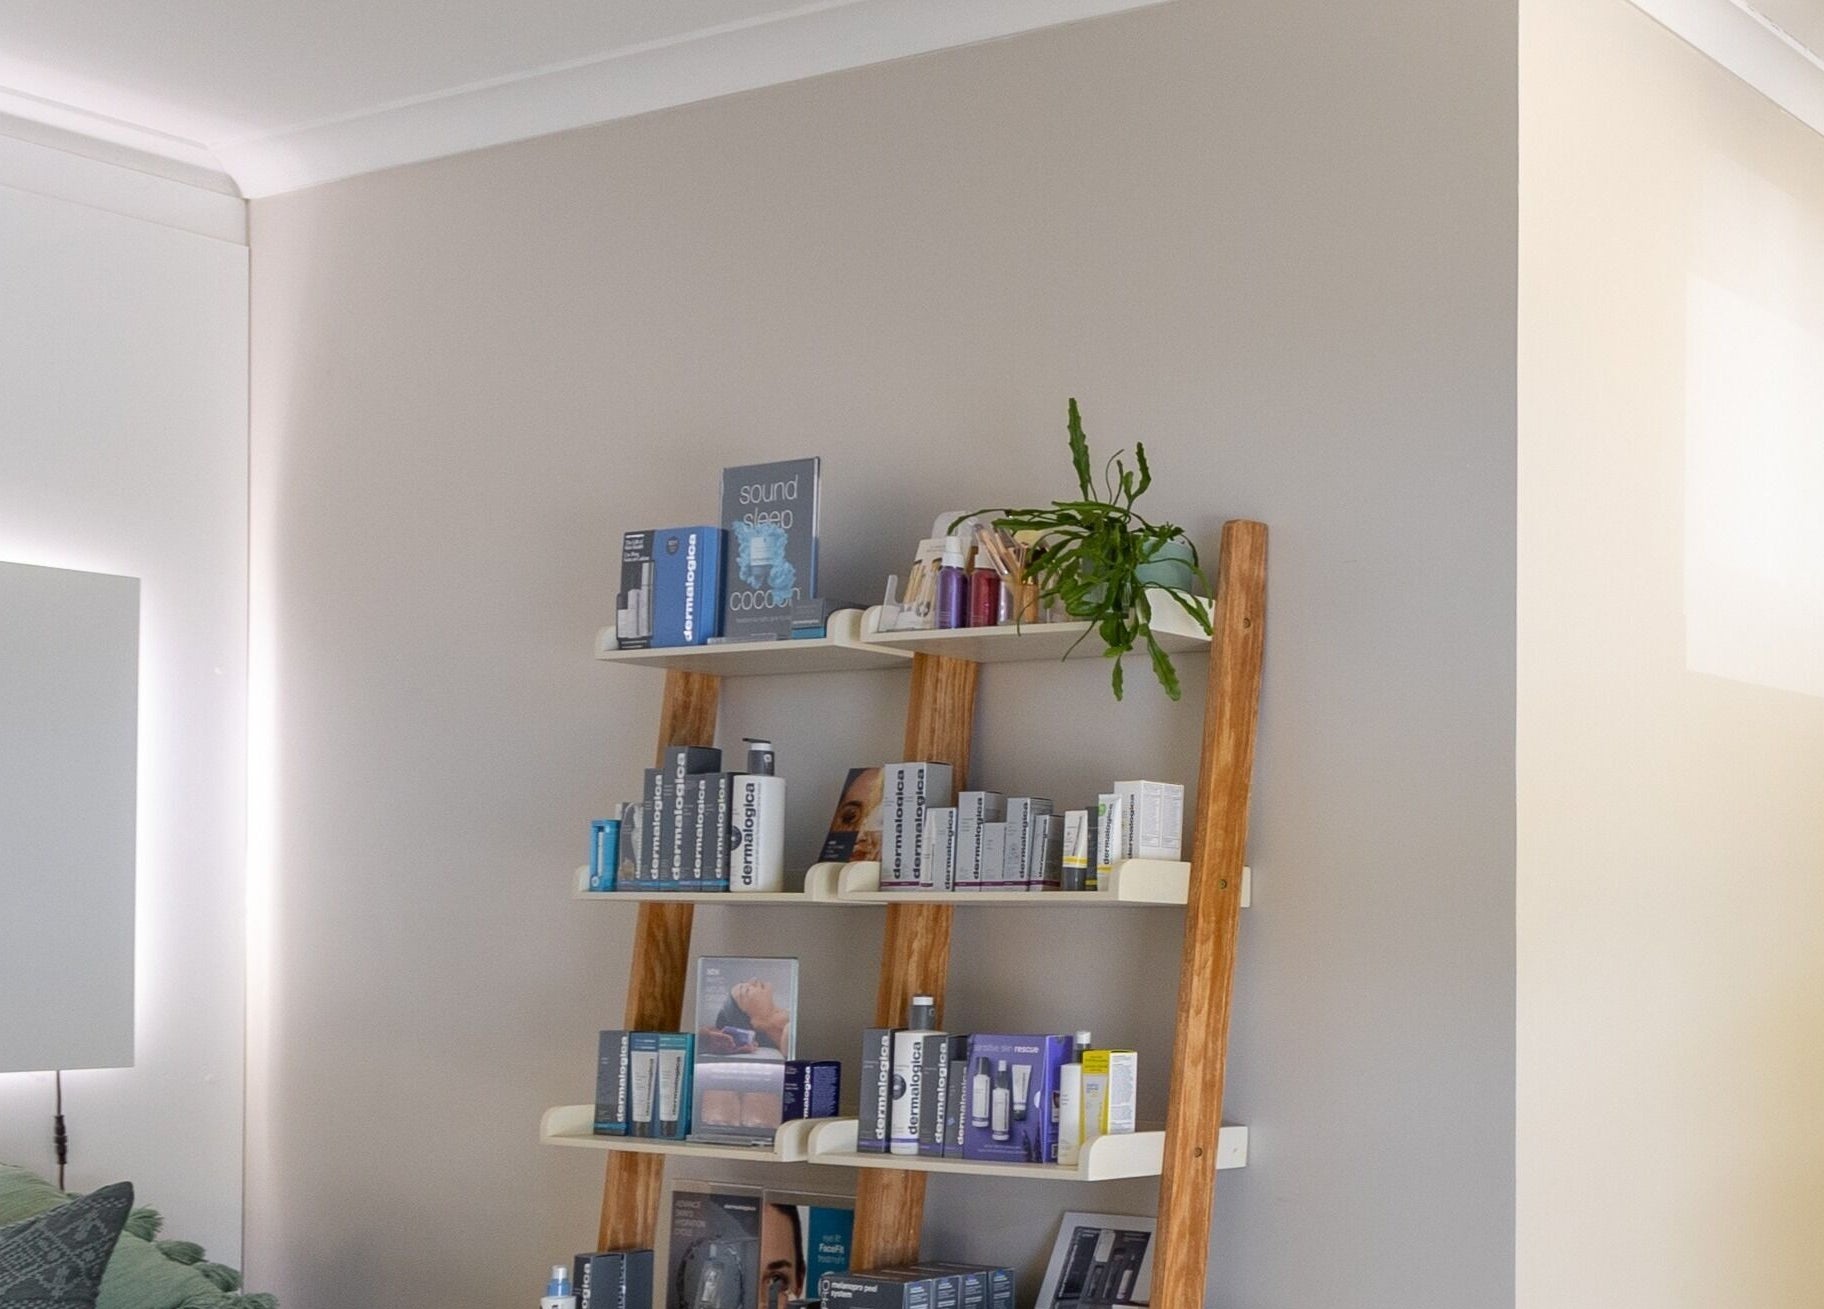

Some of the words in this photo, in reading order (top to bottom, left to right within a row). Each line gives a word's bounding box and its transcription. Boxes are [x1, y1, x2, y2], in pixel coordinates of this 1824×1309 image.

[739, 474, 798, 505] sound
[683, 533, 697, 642] dermalogica
[651, 774, 663, 880] dermalogica
[672, 752, 686, 880] dermalogica
[693, 779, 706, 878] dermalogica
[715, 778, 726, 878] dermalogica
[742, 782, 756, 885] dermalogica
[893, 769, 905, 880] dermalogica
[913, 768, 925, 879] dermalogica
[973, 797, 983, 880] dermalogica
[617, 1036, 629, 1123] dermalogica
[875, 1034, 889, 1140] dermalogica
[908, 1041, 922, 1135] dermalogica
[934, 1042, 947, 1144] dermalogica
